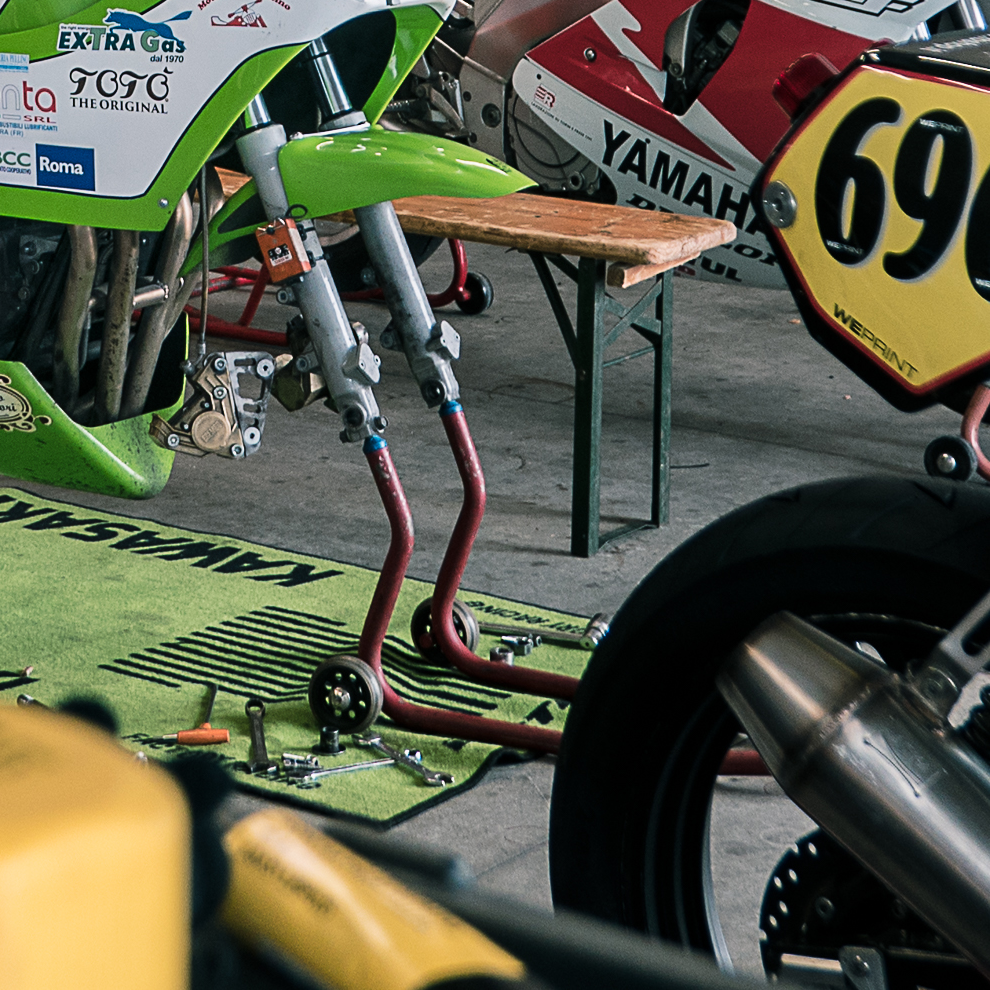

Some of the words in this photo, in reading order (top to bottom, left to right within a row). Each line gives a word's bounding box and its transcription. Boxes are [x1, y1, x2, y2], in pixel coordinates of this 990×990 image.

[58, 27, 136, 51] EXTRA
[140, 29, 186, 54] Gas
[149, 54, 163, 63] dal
[165, 54, 184, 63] 1970
[70, 97, 98, 109] THE
[99, 98, 168, 115] ORIGINAL
[23, 115, 57, 124] SRL
[24, 123, 58, 132] LUBRIFICANTI
[919, 117, 965, 134] WEPRINT
[10, 129, 24, 138] (FR)
[39, 156, 84, 176] Roma
[833, 301, 920, 378] WEPRINT
